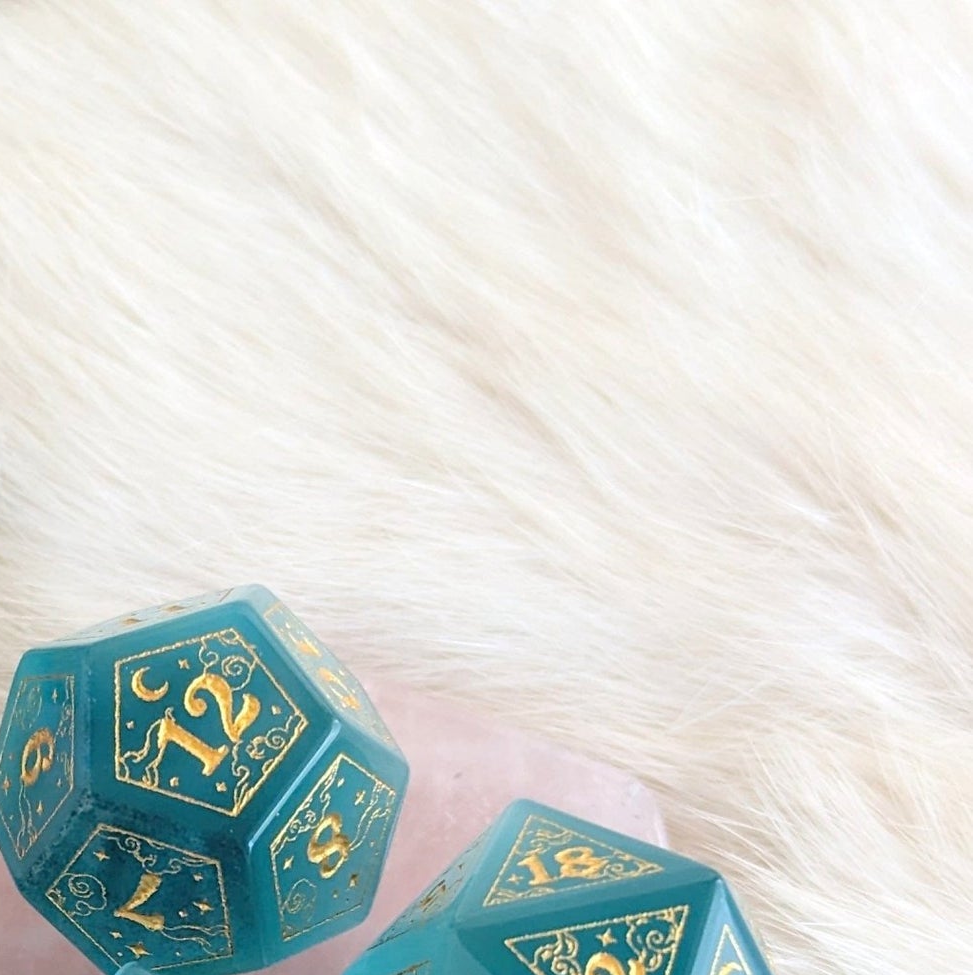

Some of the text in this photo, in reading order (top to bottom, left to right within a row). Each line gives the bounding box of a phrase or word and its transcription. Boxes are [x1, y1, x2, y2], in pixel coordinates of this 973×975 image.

[158, 673, 261, 777] 12
[306, 813, 350, 879] 8
[516, 846, 601, 886] 18
[114, 872, 166, 931] 7
